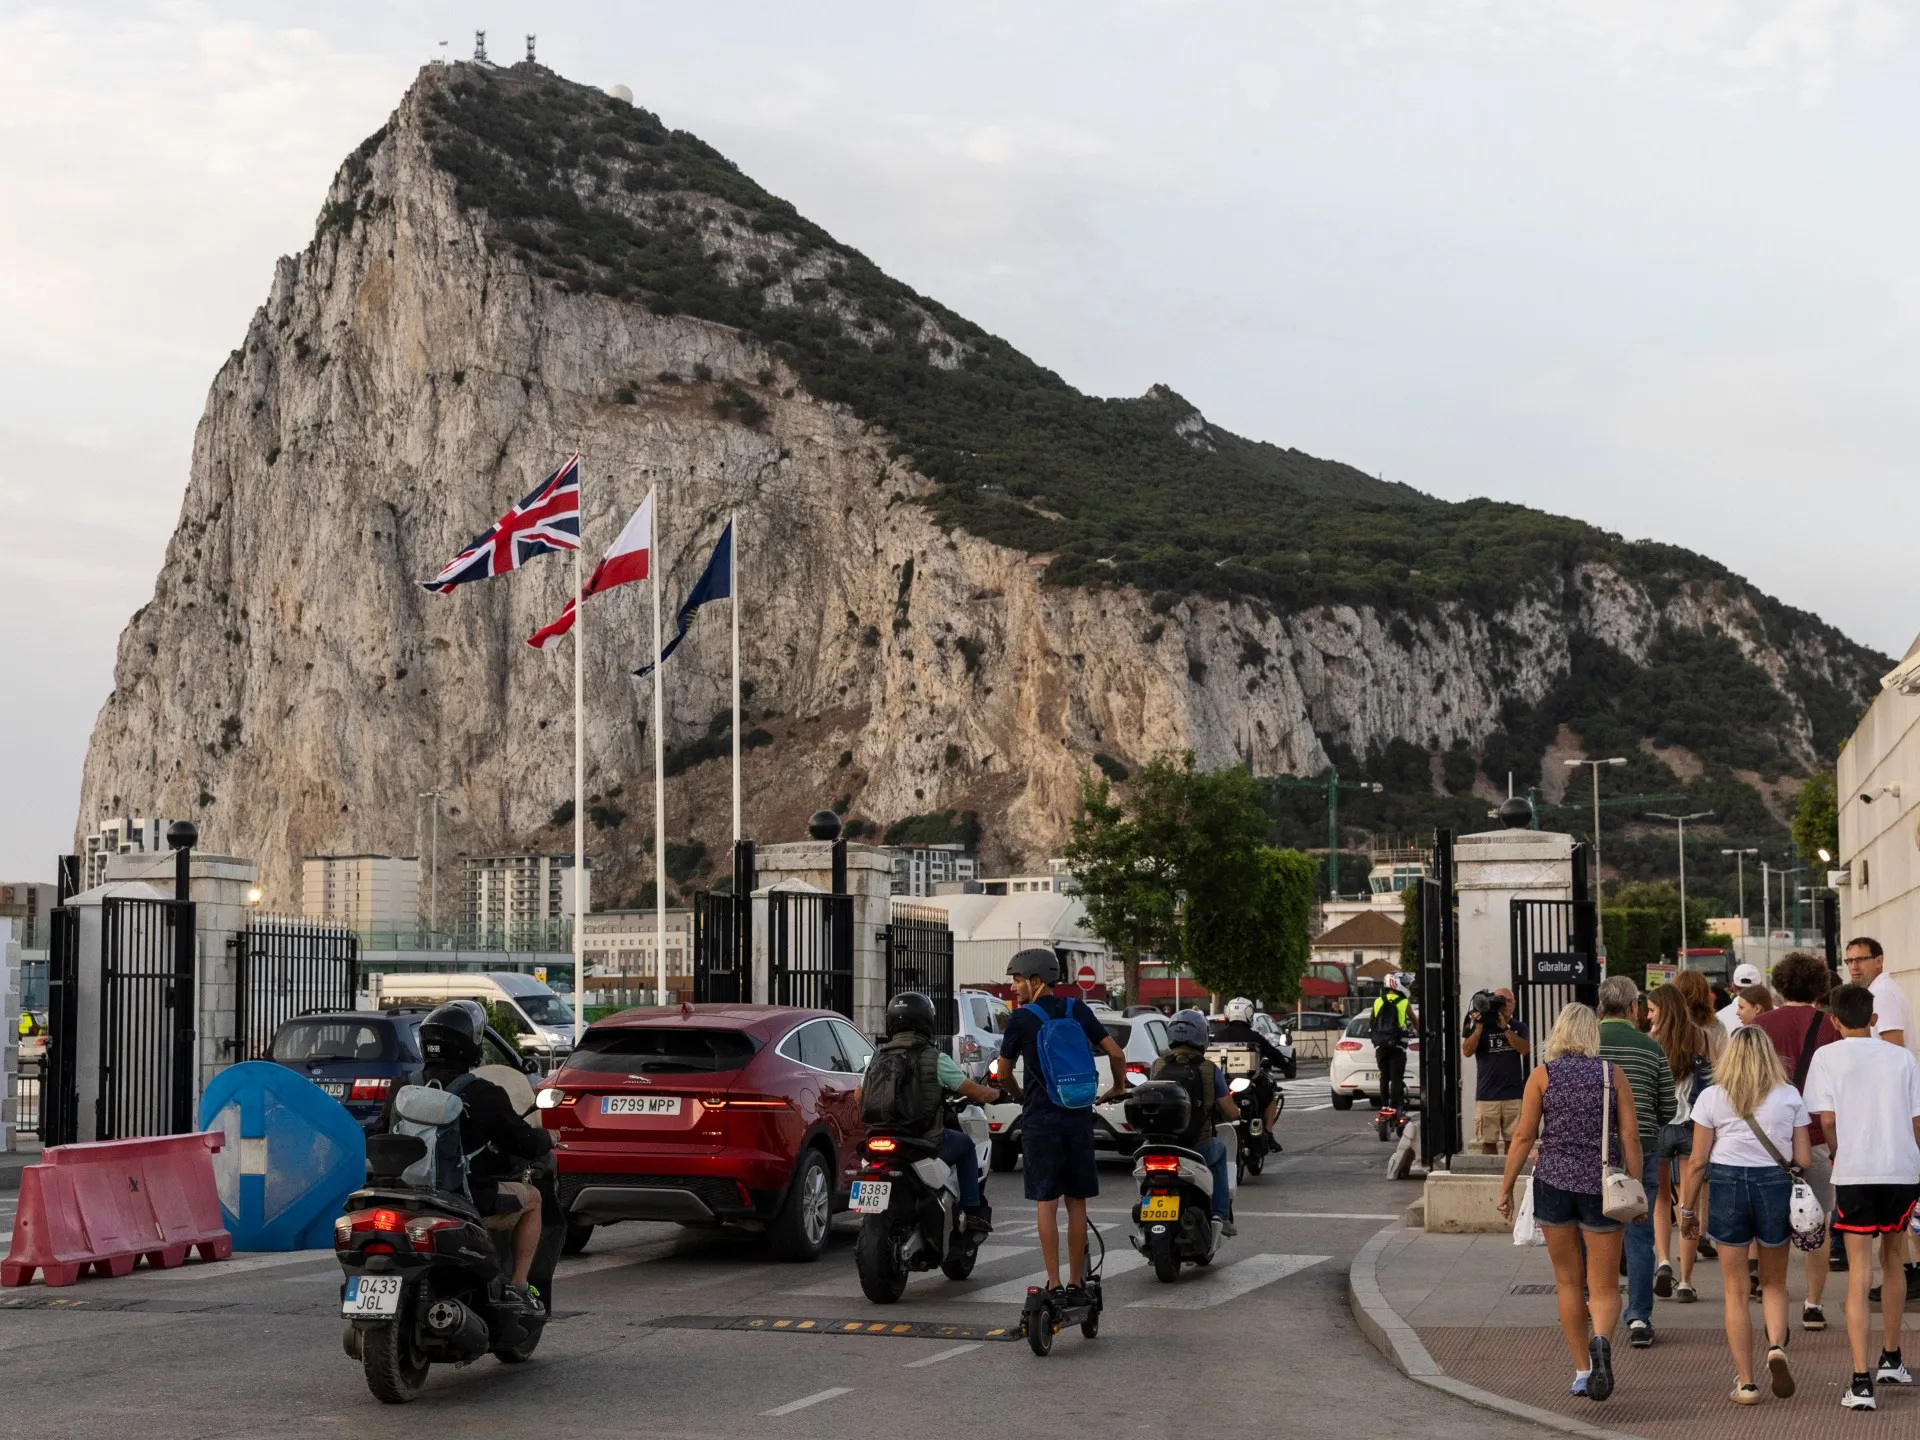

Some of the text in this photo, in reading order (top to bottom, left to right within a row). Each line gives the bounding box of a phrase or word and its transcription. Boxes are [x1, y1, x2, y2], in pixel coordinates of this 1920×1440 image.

[1538, 961, 1572, 972] Gibraltar
[611, 1099, 645, 1112] 6799
[648, 1099, 675, 1112] MPP
[860, 1184, 889, 1195] 8383
[858, 1195, 880, 1207] MXG
[1157, 1200, 1164, 1208] G
[360, 1279, 398, 1294] 0433
[356, 1295, 383, 1310] JGL
